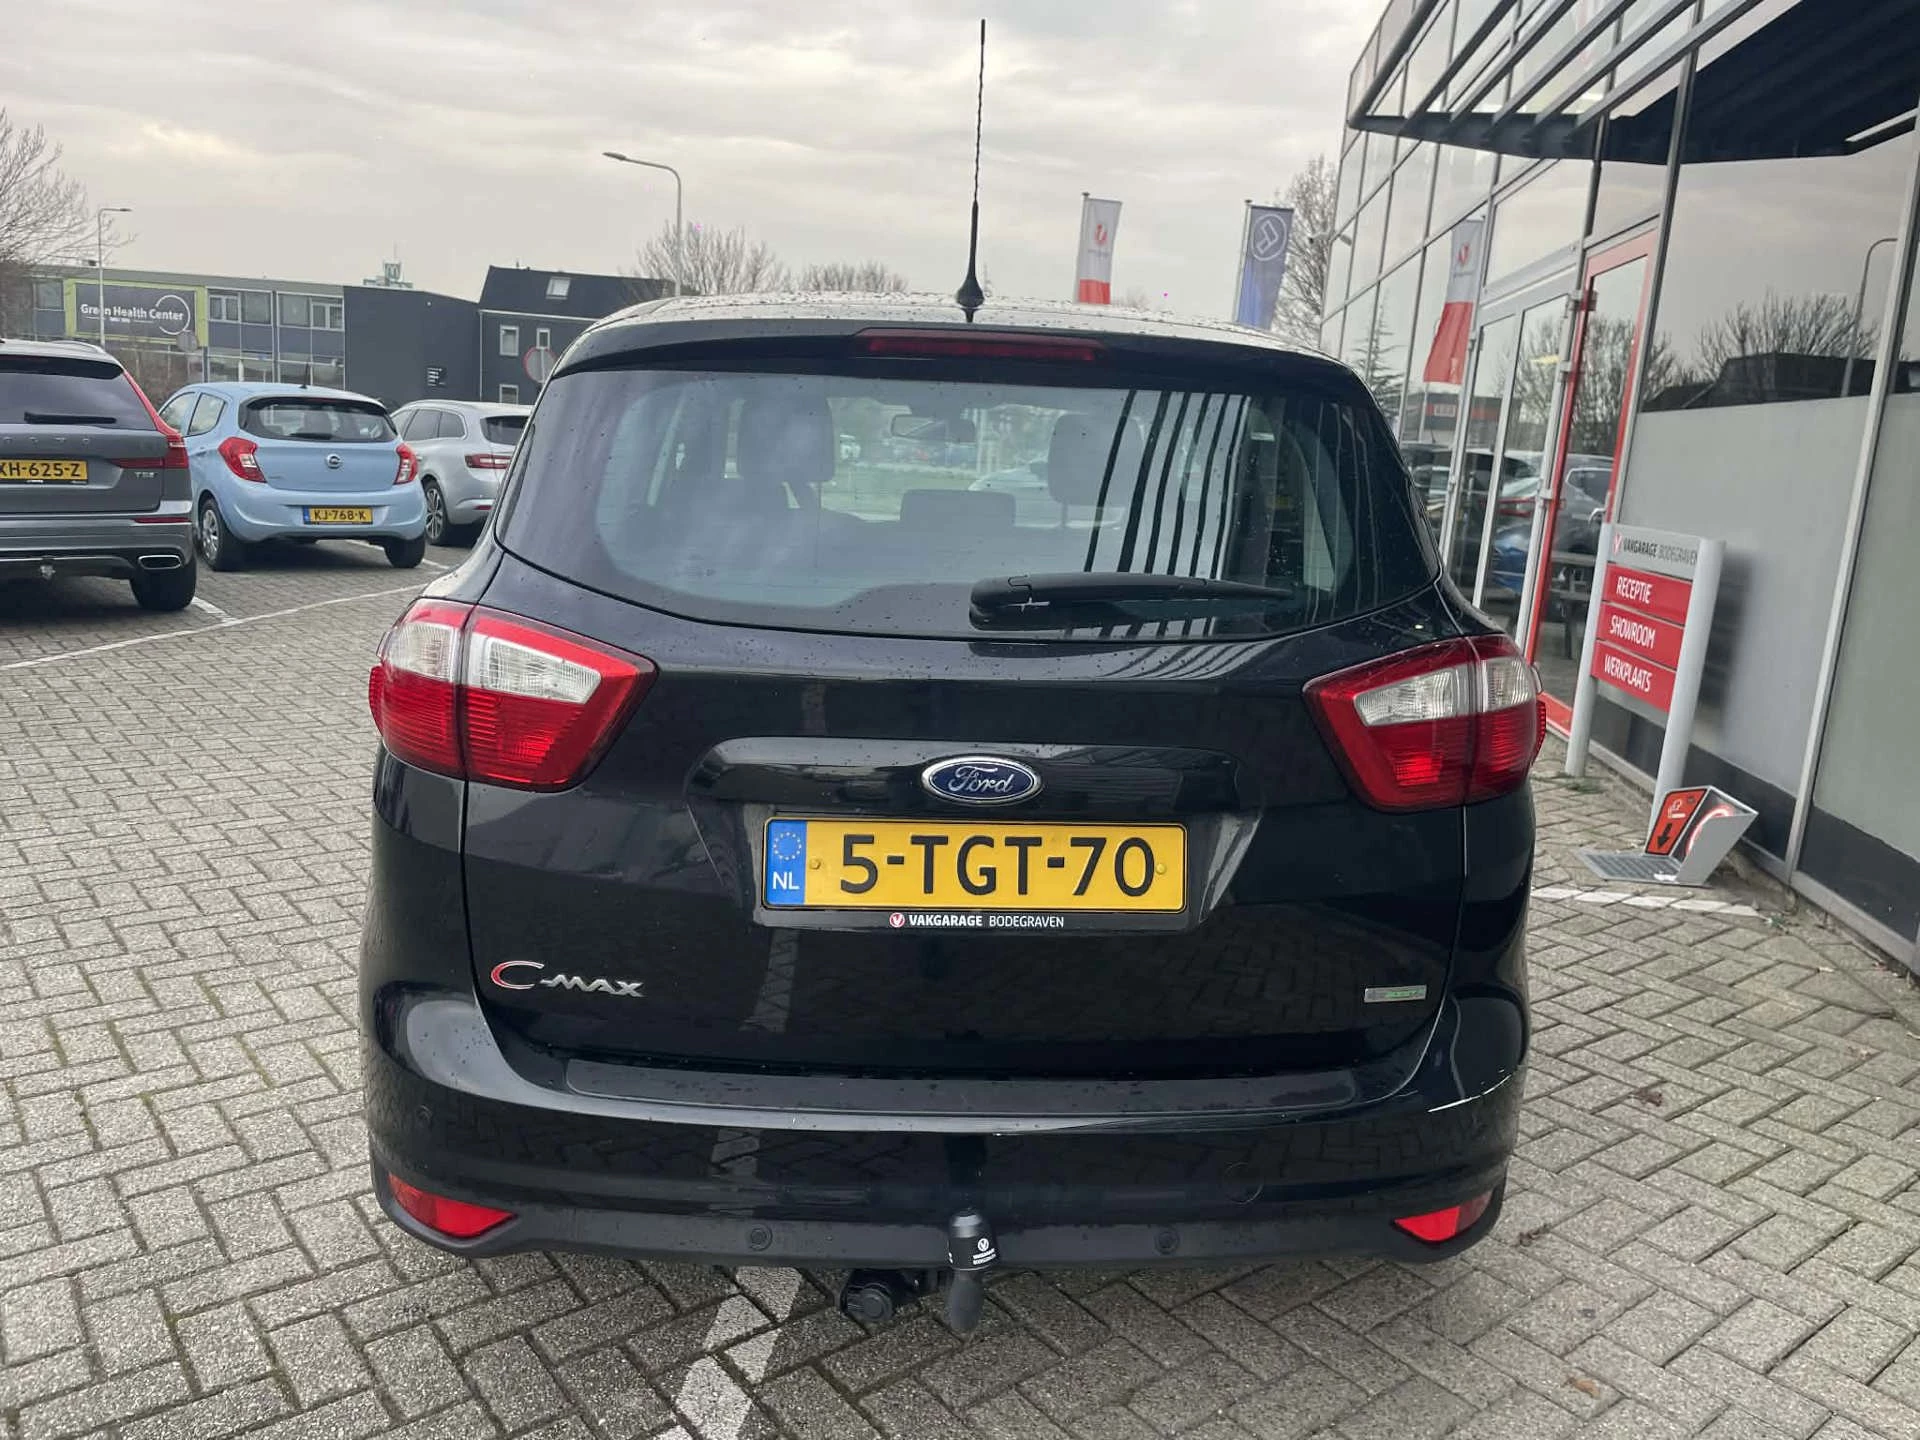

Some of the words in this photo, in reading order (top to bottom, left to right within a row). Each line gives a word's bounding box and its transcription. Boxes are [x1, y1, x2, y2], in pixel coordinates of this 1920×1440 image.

[80, 303, 112, 316] Gren
[113, 305, 147, 319] Health
[149, 308, 184, 321] Center
[0, 462, 81, 477] XH-625-Z
[314, 509, 366, 521] KJ-768-K
[1616, 575, 1653, 604] RECEPTIE
[1609, 614, 1656, 649] SHOWROOM
[1604, 654, 1653, 693] WERKPLAATS
[948, 765, 1014, 792] Ford
[839, 833, 1156, 897] 5-TGT-70
[772, 871, 800, 890] NL
[909, 914, 983, 927] VAKGARAGE
[989, 915, 1064, 928] BODEGRAVEN
[490, 960, 645, 998] C-MAX
